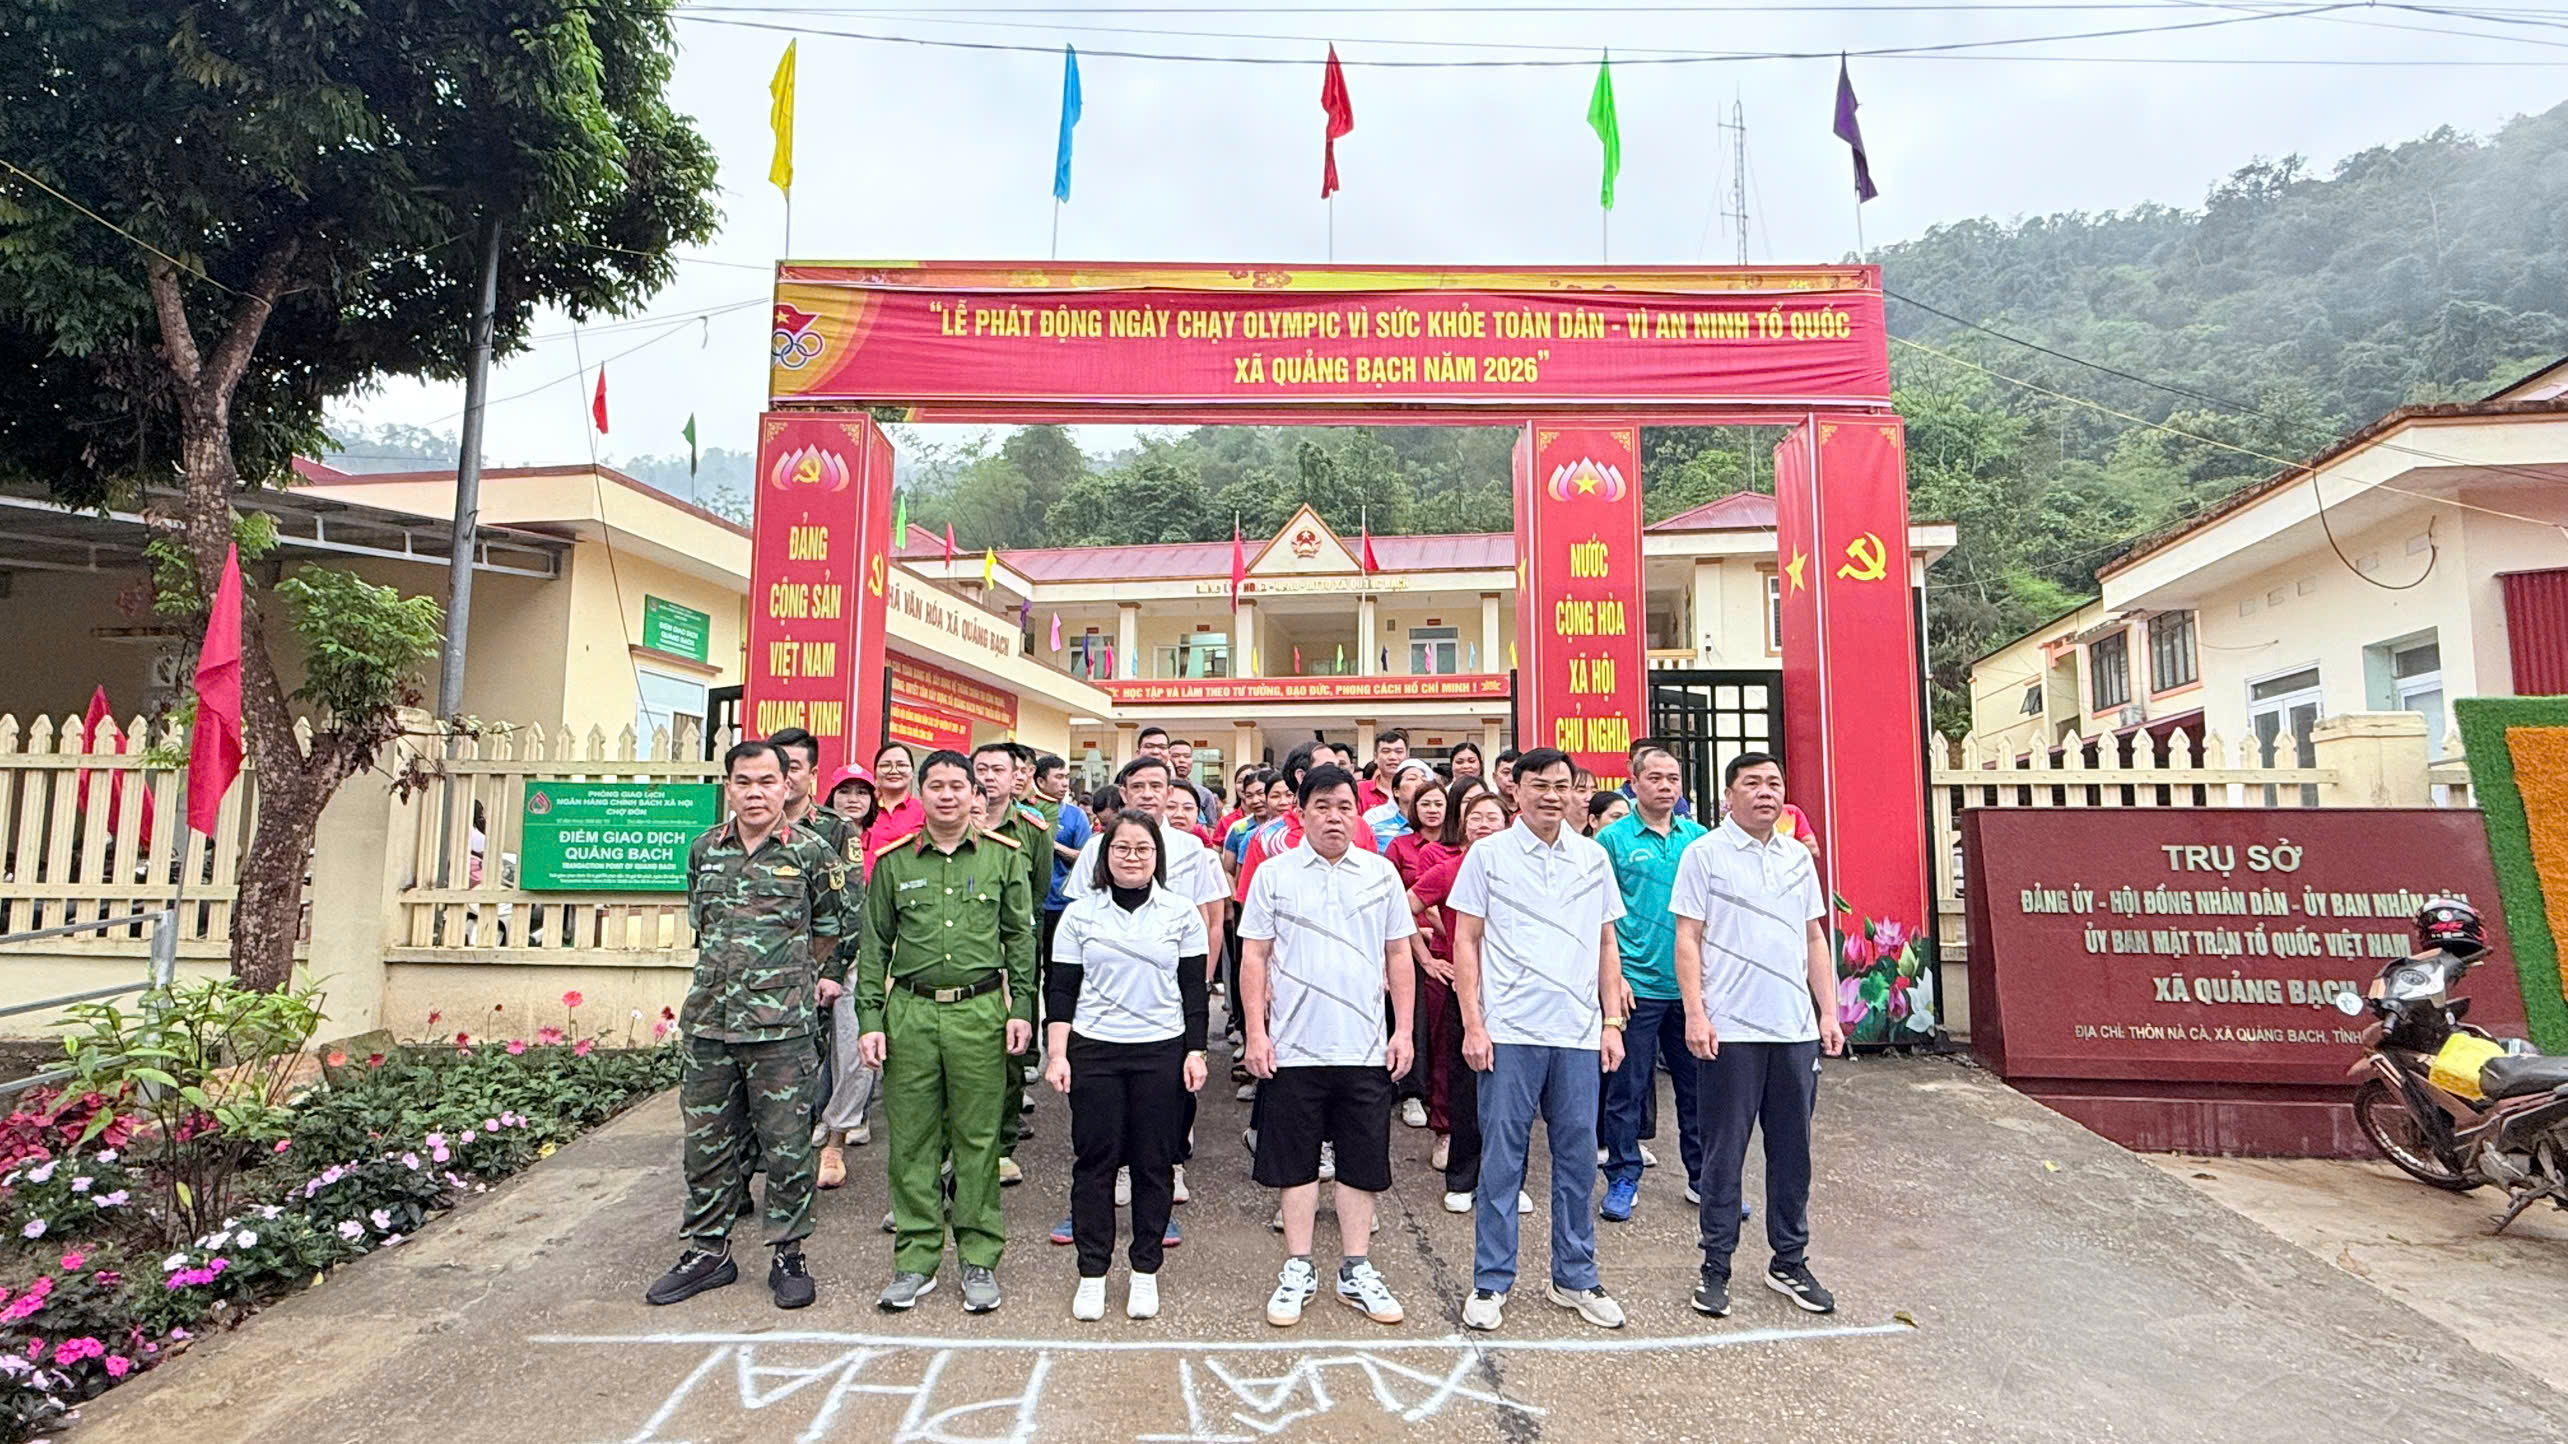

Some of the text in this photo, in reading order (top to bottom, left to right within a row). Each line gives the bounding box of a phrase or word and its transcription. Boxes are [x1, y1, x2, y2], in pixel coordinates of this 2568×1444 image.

[929, 299, 968, 336] “LỄ
[975, 304, 1034, 337] PHÁT
[1039, 304, 1102, 343] ĐỘNG
[1109, 303, 1170, 338] NGÀY
[1177, 310, 1237, 344] CHẠY
[1243, 311, 1341, 339] OLYMPIC
[1347, 305, 1369, 338] VÌ
[1375, 305, 1421, 338] SỨC
[1427, 302, 1486, 338] KHỎE
[1493, 306, 1552, 339] TOÀN
[1558, 307, 1605, 339] DÂN
[1627, 307, 1648, 339] VÌ
[1655, 312, 1687, 339] AN
[1693, 312, 1750, 339] NINH
[1755, 301, 1784, 339] TỔ
[1790, 302, 1851, 341] QUỐC
[1234, 348, 1550, 388] XÃ QUẢNG BẠCH NĂM 2026”
[789, 511, 829, 560] ĐẢNG
[1570, 532, 1608, 578] NƯỚC
[769, 569, 842, 626] CỘNG SẢN
[1555, 592, 1626, 643] CỘNG HÒA
[888, 582, 1010, 658] HÀ VĂN HÓA XÃ QUẢNG BẠCH
[769, 634, 836, 685] VIỆT NAM
[1569, 651, 1616, 702] XÃ HỘI
[1123, 687, 1143, 700] HỌC
[1145, 685, 1164, 698] TẬP
[1166, 685, 1179, 697] VÀ
[1182, 685, 1203, 697] LÀM
[1206, 686, 1231, 697] THEO
[1232, 685, 1246, 696] TƯ
[1286, 685, 1307, 698] ĐẠO
[1335, 685, 1371, 696] PHONG
[1373, 682, 1401, 695] CÁCH
[1404, 681, 1419, 694] HỒ
[1421, 681, 1439, 694] CHÍ
[1442, 682, 1470, 693] MINH
[757, 700, 843, 739] QUANG VINH
[1555, 702, 1631, 753] CHỦ NGHĨA
[559, 828, 685, 847] ĐIỂM GIAO DỊCH
[565, 845, 673, 863] QUẢNG BẠCH
[2161, 838, 2303, 878] TRỤ SỞ
[2021, 882, 2070, 914] ĐẢNG
[2071, 882, 2094, 914] ỦY
[2109, 885, 2142, 919] HỘI
[2144, 882, 2194, 915] ĐỒNG
[2195, 886, 2248, 916] NHÂN
[2249, 887, 2289, 916] DÂN
[2303, 884, 2327, 917] ỦY
[2330, 893, 2372, 917] BAN
[2373, 888, 2424, 918] NHÂN
[2084, 921, 2412, 961] ỦY BAN MẶT TRẬN TỔ QUỐC VIỆT NAM
[2153, 973, 2191, 1002] XÃ
[2194, 969, 2283, 1006] QUẢNG
[2075, 1024, 2098, 1040] ĐỊA
[2128, 1023, 2164, 1040] THÔN
[2168, 1023, 2187, 1040] NÀ
[2214, 1025, 2235, 1041] XÃ
